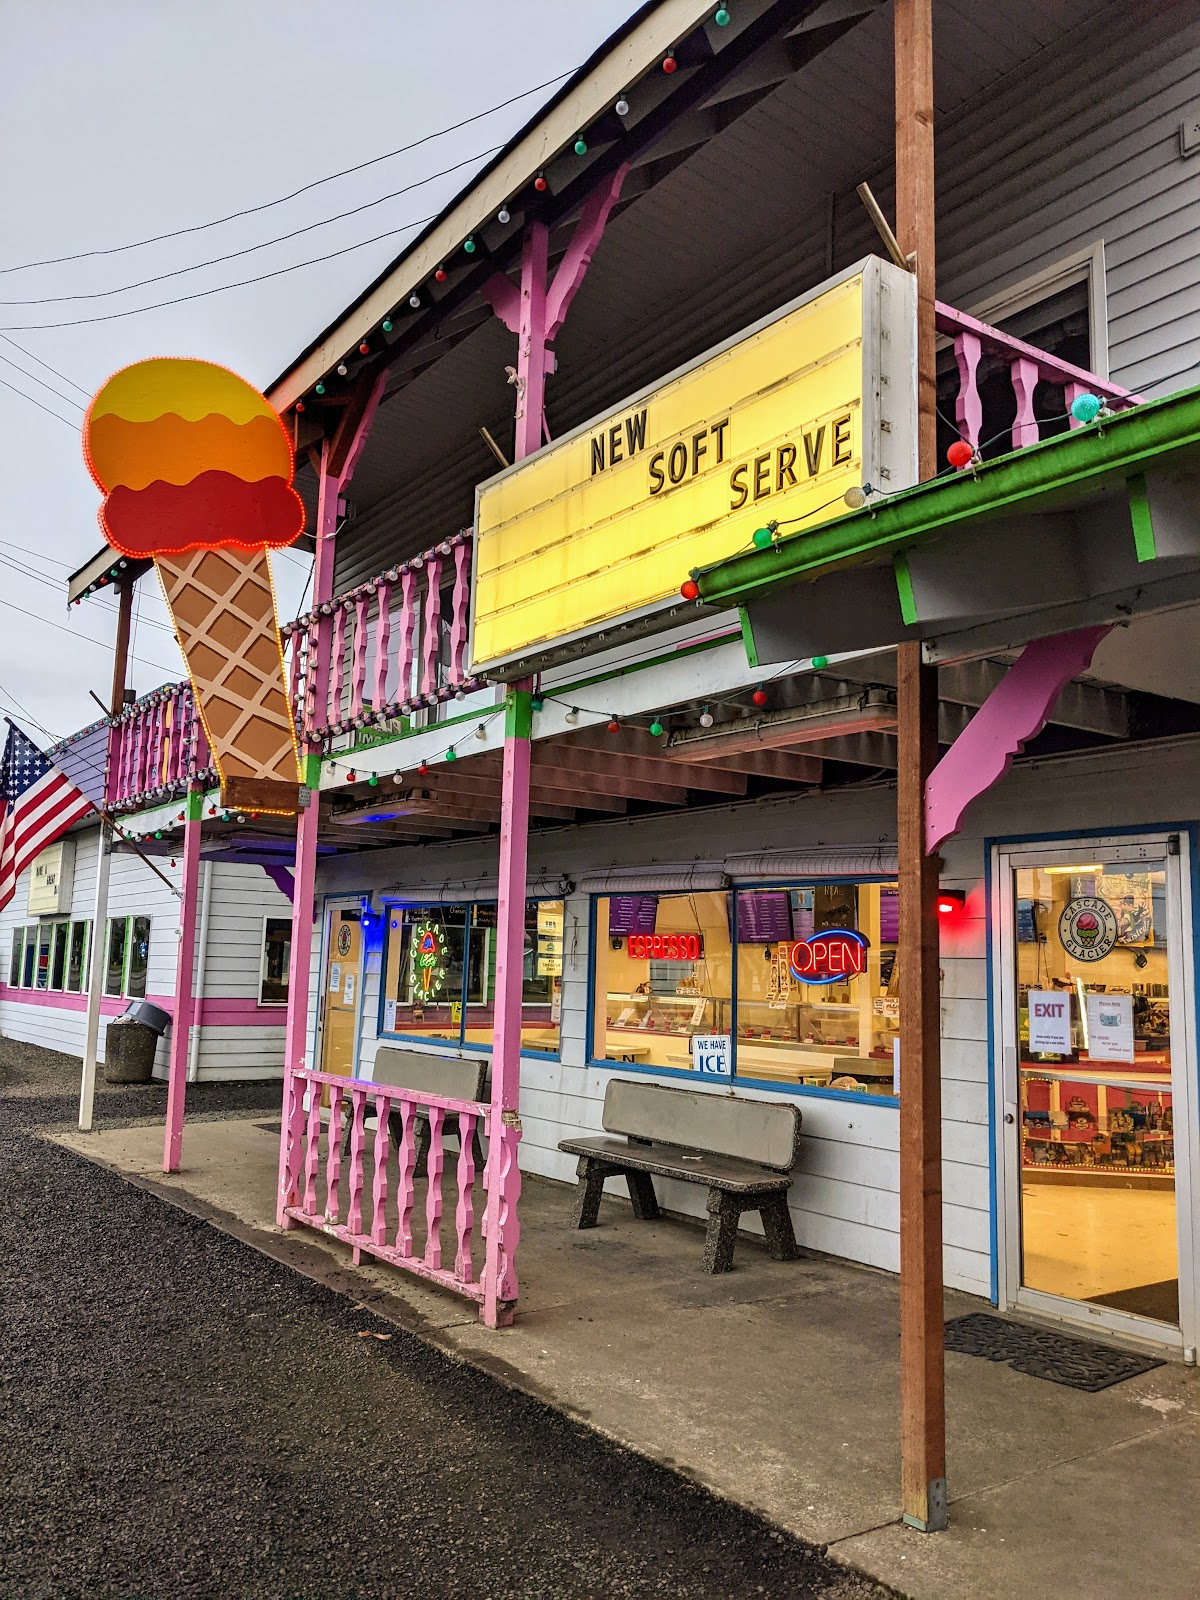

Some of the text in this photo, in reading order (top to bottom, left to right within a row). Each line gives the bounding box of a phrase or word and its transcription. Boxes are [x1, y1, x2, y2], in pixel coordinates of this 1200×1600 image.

[590, 408, 648, 476] NEW
[648, 417, 730, 496] SOFT
[730, 412, 853, 511] SERVE
[1063, 899, 1112, 922] CASCADE
[409, 920, 448, 958] CASCADE
[1117, 919, 1150, 945] Twisted!
[629, 935, 698, 960] ESPRESSO
[790, 941, 862, 972] OPEN
[1064, 937, 1112, 959] GLACIER
[409, 968, 446, 1001] GLACIER
[1034, 1003, 1064, 1018] EXIT
[697, 1040, 727, 1050] WE HAVE
[699, 1054, 726, 1073] ICE
